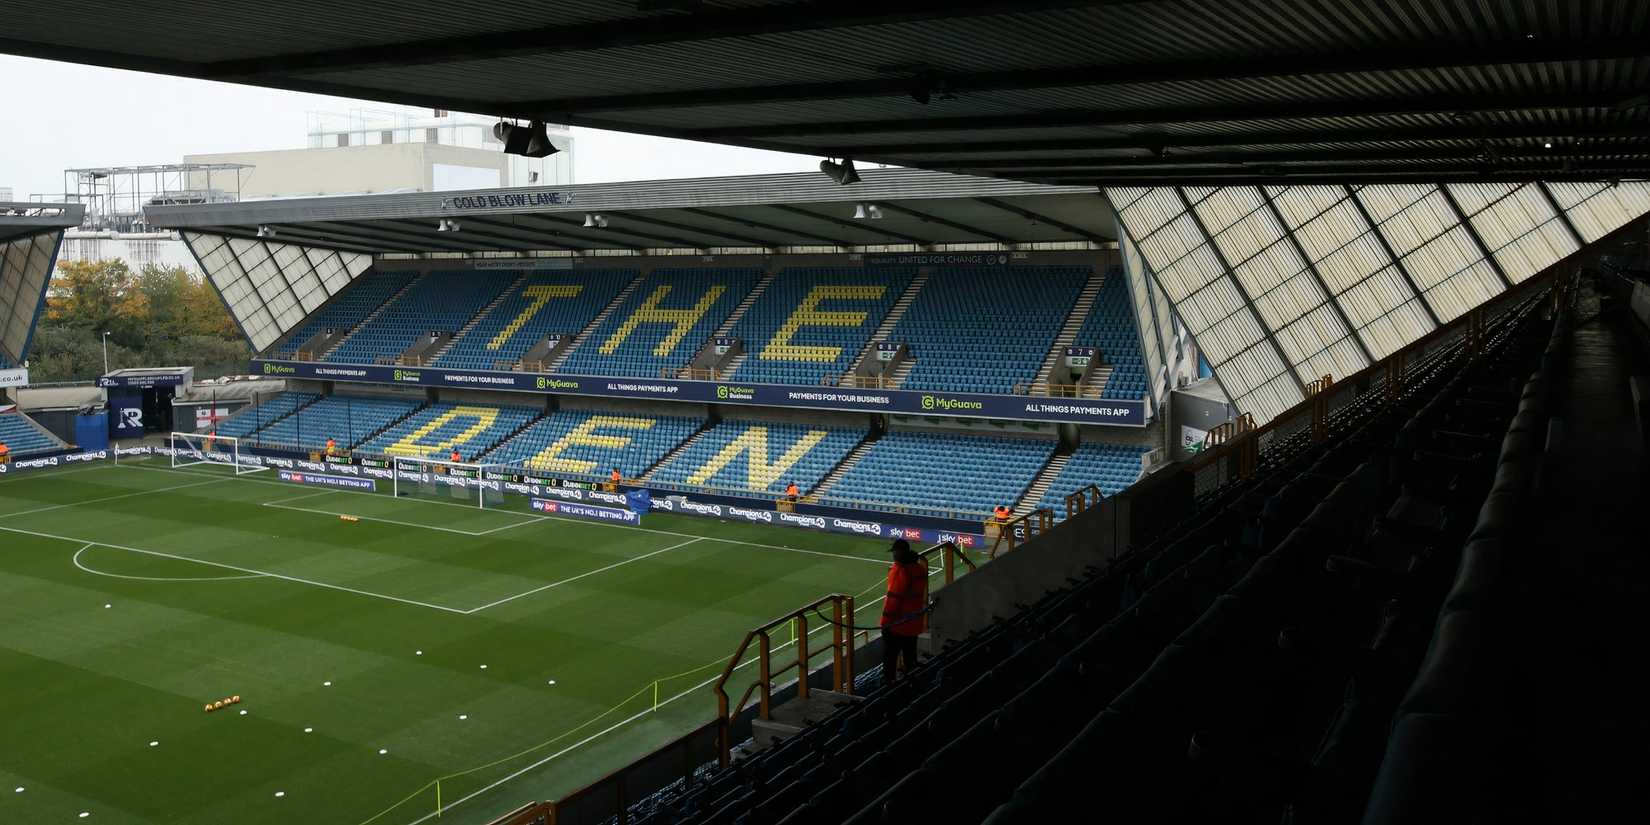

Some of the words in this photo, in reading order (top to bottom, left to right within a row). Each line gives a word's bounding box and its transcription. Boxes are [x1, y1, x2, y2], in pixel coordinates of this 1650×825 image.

[453, 195, 486, 208] COLD
[488, 194, 525, 207] BLOW
[528, 192, 562, 206] LANE
[900, 255, 928, 264] UNITED
[929, 255, 945, 264] FOR
[948, 255, 981, 264] CHANGE
[487, 285, 887, 362] THE
[478, 376, 491, 384] YOUR
[547, 379, 578, 389] MyGuava
[729, 392, 752, 400] Business
[789, 392, 822, 400] PAYMENTS
[823, 393, 836, 401] FOR
[837, 394, 856, 402] YOUR
[857, 396, 889, 404] BUSINESS
[936, 398, 982, 411] MyGuava
[1025, 404, 1040, 412] ALL
[1041, 405, 1069, 414] THINGS
[1070, 406, 1112, 416] PAYMENTS
[1113, 408, 1129, 417] APP
[360, 480, 370, 488] APP
[533, 502, 544, 511] sky
[544, 502, 556, 512] bet
[560, 505, 570, 513] THE
[571, 506, 584, 515] UK'S
[599, 510, 622, 519] BETTING
[623, 511, 635, 521] APP
[890, 526, 903, 539] sky
[905, 528, 920, 539] bet
[941, 533, 955, 544] sky
[957, 534, 972, 545] bet
